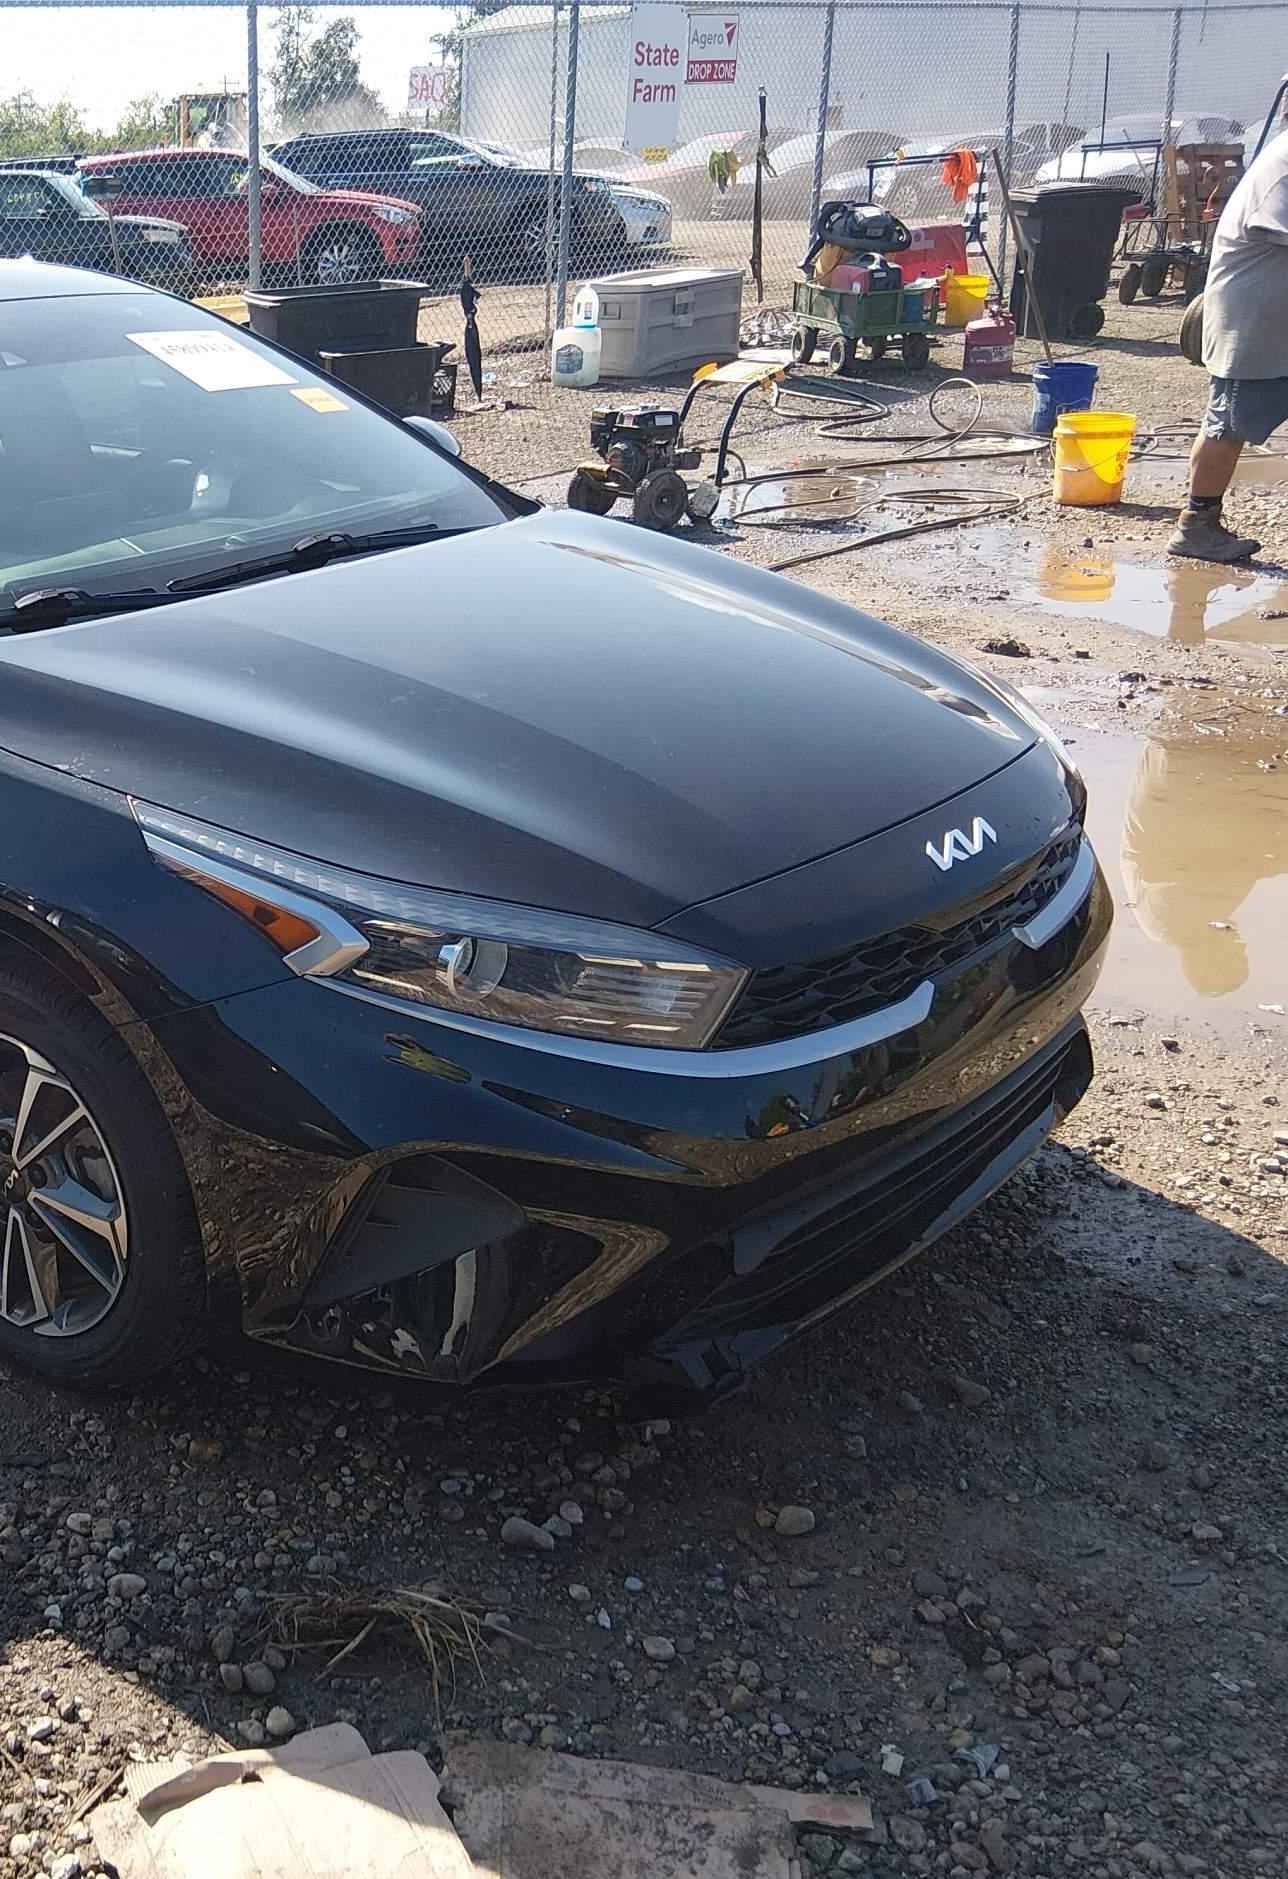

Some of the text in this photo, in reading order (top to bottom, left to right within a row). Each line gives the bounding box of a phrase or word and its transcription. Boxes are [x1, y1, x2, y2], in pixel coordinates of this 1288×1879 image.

[692, 29, 724, 50] Agero
[634, 41, 680, 67] State
[688, 62, 735, 80] DROP ZONE
[633, 78, 676, 103] Farm
